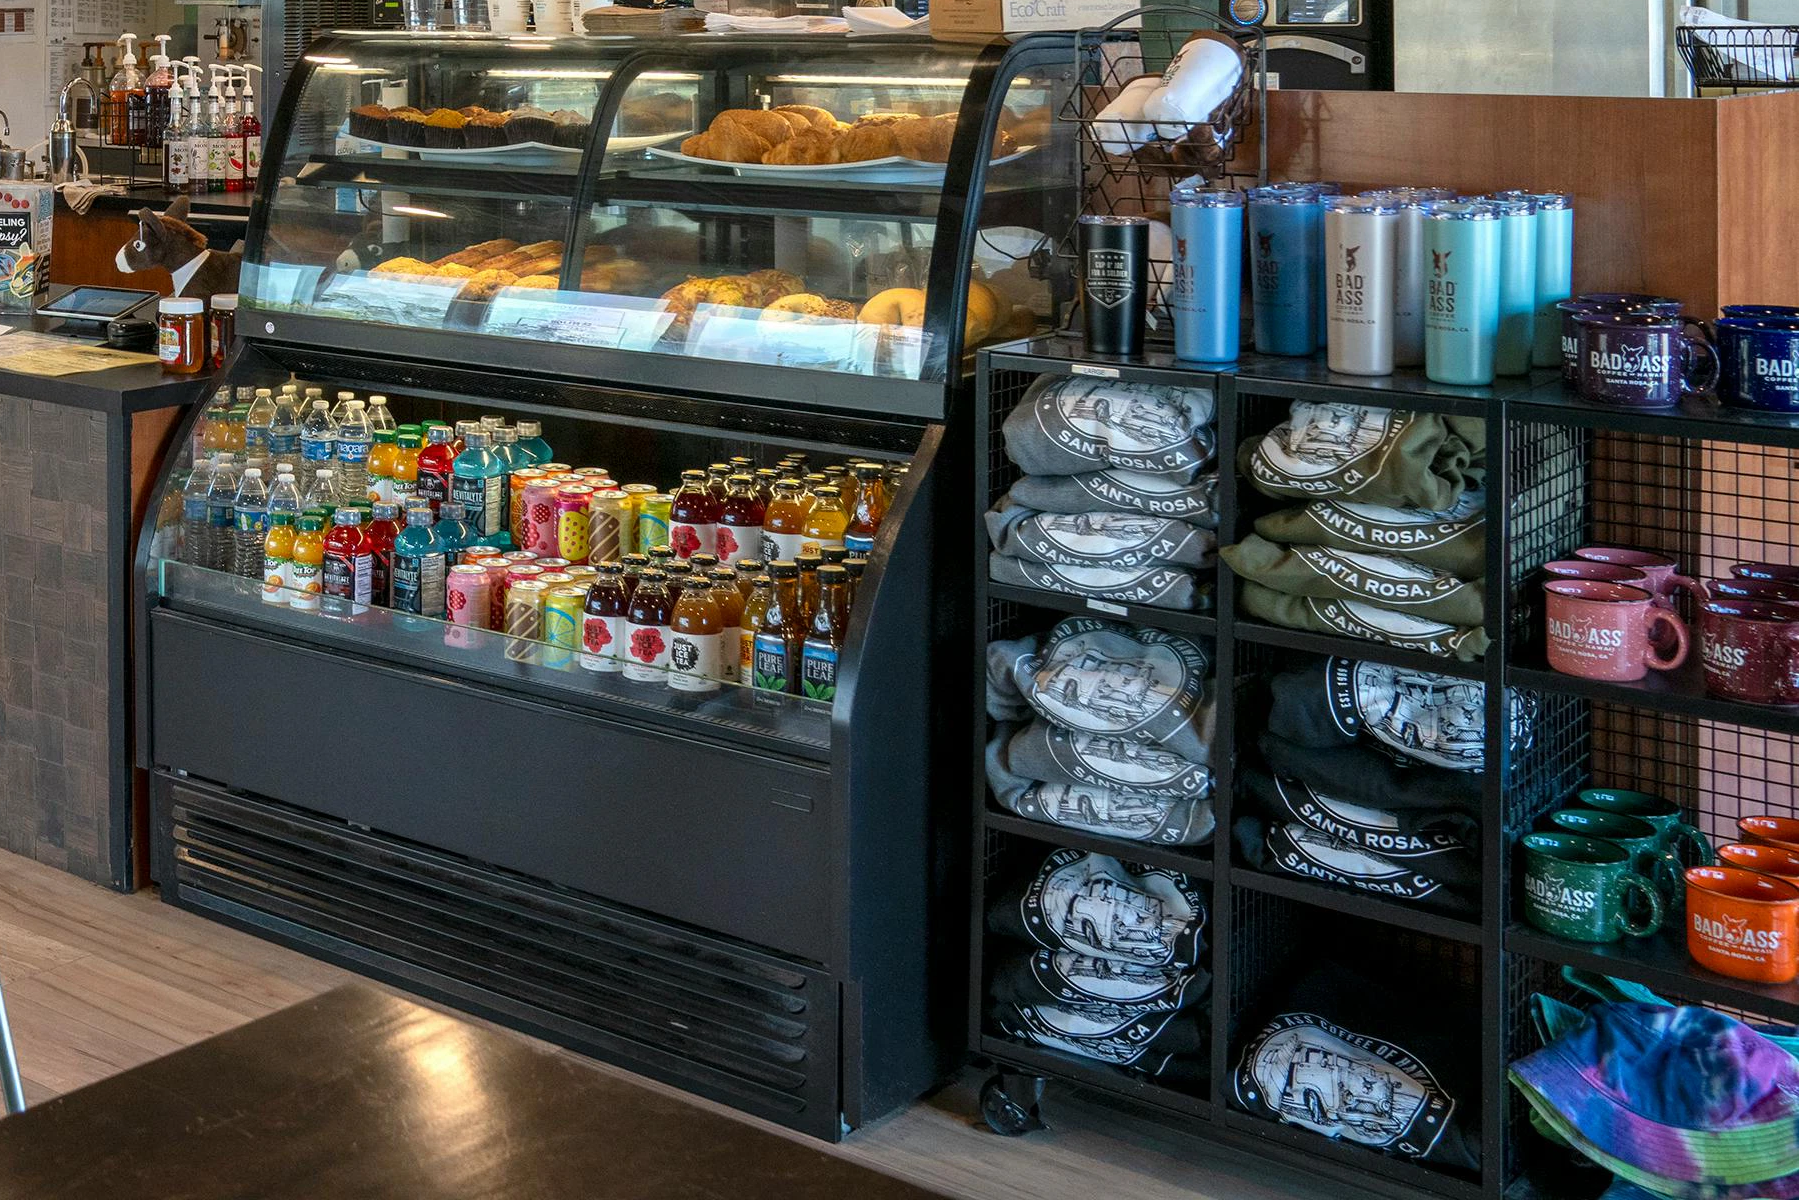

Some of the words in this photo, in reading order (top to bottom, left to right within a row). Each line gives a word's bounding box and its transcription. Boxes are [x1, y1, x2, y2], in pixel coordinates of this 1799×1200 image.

[1106, 269, 1128, 278] SOLDIER
[1336, 274, 1363, 290] BAD
[1429, 280, 1456, 296] BAD
[1336, 290, 1363, 306] ASS
[1429, 297, 1455, 313] ASS
[1591, 351, 1621, 370] BAD
[1641, 355, 1669, 372] ASS
[1755, 358, 1790, 377] BAD
[1597, 369, 1628, 377] COFFEE
[337, 443, 369, 454] niagara
[1108, 454, 1163, 471] ROSA,
[1165, 450, 1189, 467] CA
[1344, 469, 1364, 485] CA
[453, 490, 483, 502] REVITALYTE
[1088, 477, 1144, 509] SANTA
[1149, 496, 1205, 513] ROSA,
[1311, 502, 1365, 539] SANTA
[1371, 529, 1435, 545] ROSA,
[1438, 522, 1466, 534] CA
[1152, 539, 1175, 558] CA
[1153, 570, 1178, 588] CA
[1307, 551, 1358, 588] SANTA
[1365, 580, 1431, 597] ROSA,
[1435, 577, 1463, 591] CA
[1549, 617, 1570, 639] BAD
[1587, 627, 1622, 647] ASS
[674, 642, 692, 652] JUST
[675, 650, 689, 659] ICE
[675, 657, 689, 666] TEA
[758, 652, 783, 664] PURE
[807, 659, 834, 672] PURE
[1713, 648, 1745, 666] ASS
[758, 660, 783, 674] LEAF
[807, 668, 834, 682] LEAF
[1341, 688, 1351, 708] EST.
[1183, 769, 1206, 789] CA
[1299, 802, 1359, 844] SANTA
[1365, 833, 1431, 850] ROSA,
[1285, 852, 1349, 884] SANTA
[1525, 873, 1544, 895] BAD
[1560, 890, 1594, 908] ASS
[1694, 913, 1720, 939] BAD
[1742, 929, 1779, 949] ASS
[1127, 1023, 1151, 1041] CA
[1285, 1014, 1314, 1027] ASS
[1320, 1019, 1373, 1051] COFFEE
[1375, 1044, 1397, 1063] OF
